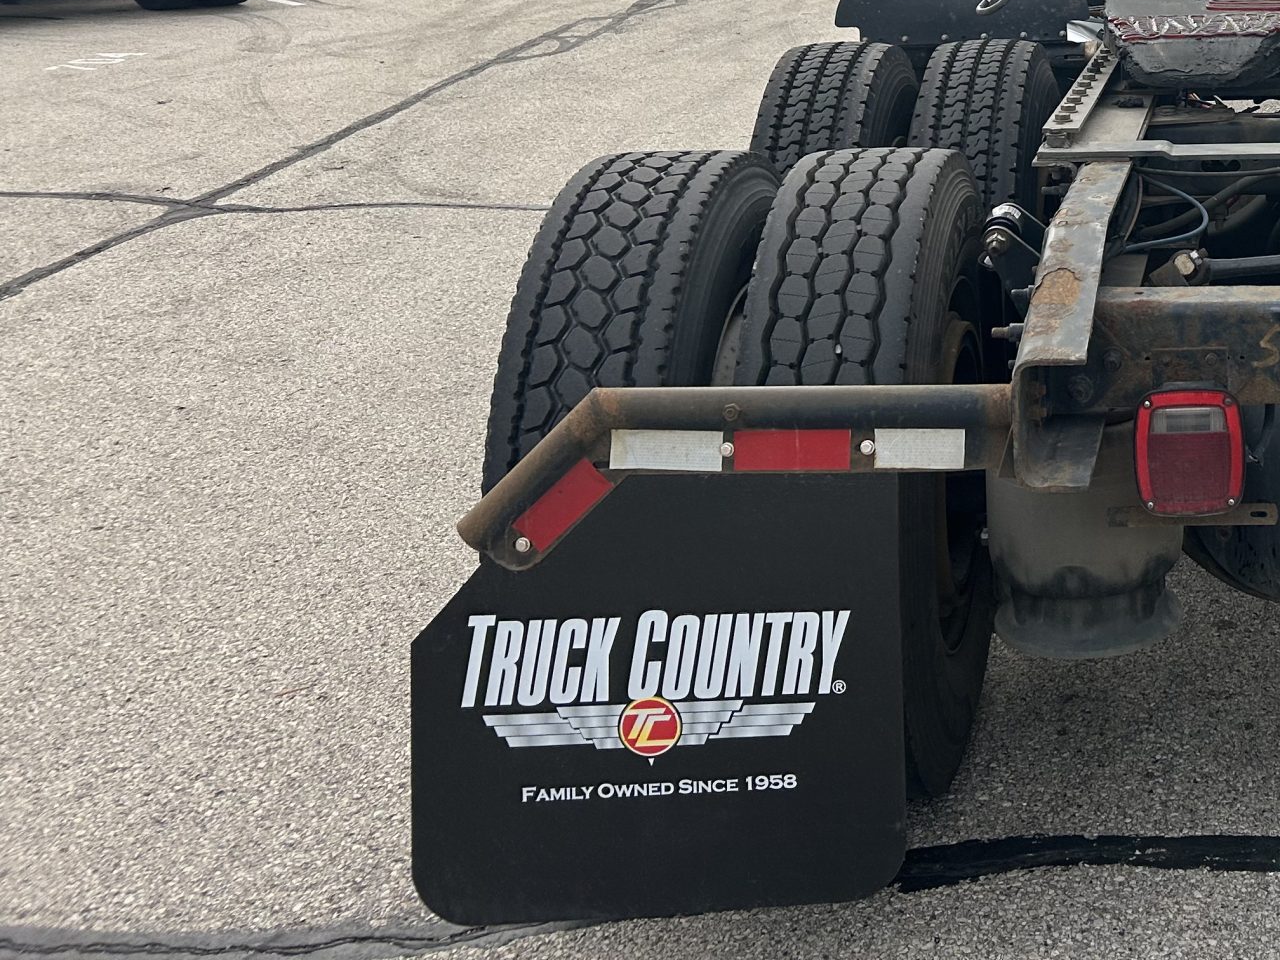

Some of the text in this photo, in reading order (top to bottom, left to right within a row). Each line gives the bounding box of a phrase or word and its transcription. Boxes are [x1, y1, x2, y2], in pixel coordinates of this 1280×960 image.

[460, 609, 851, 708] TRUCK COUNTRY
[521, 773, 798, 804] FAMILY OWNED SINCE 1958
